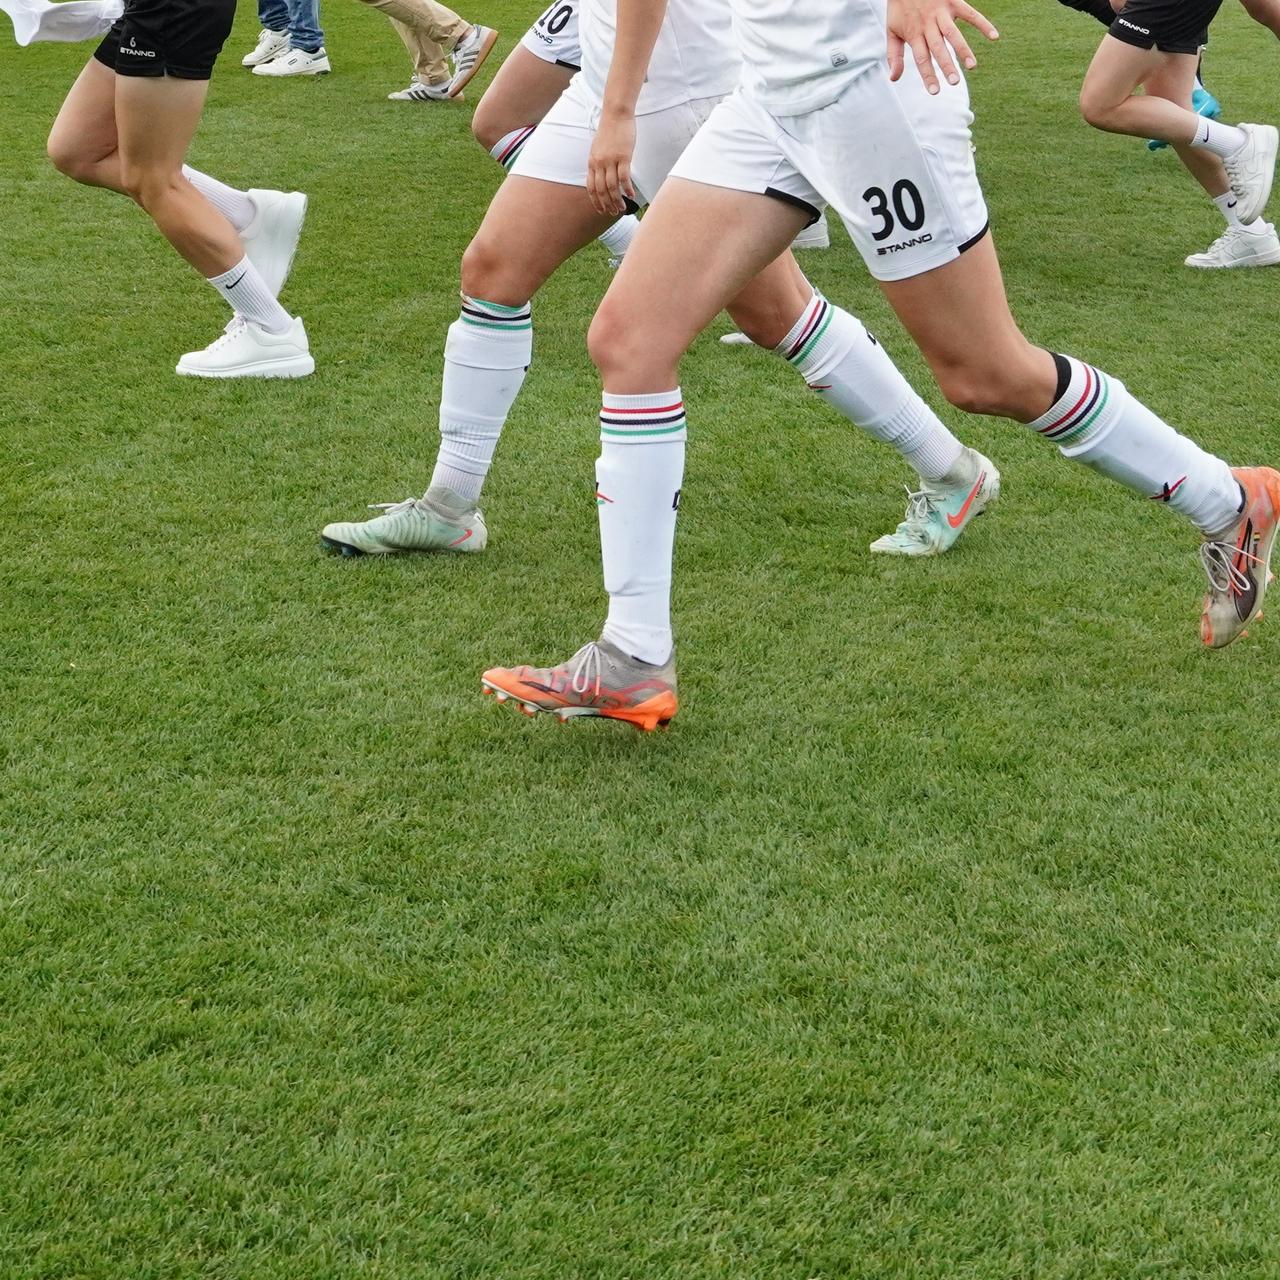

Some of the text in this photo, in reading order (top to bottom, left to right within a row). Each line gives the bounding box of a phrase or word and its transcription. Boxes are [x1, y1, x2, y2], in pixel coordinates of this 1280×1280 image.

[130, 37, 136, 47] 6
[862, 179, 925, 241] 30
[877, 233, 933, 256] STANNO
